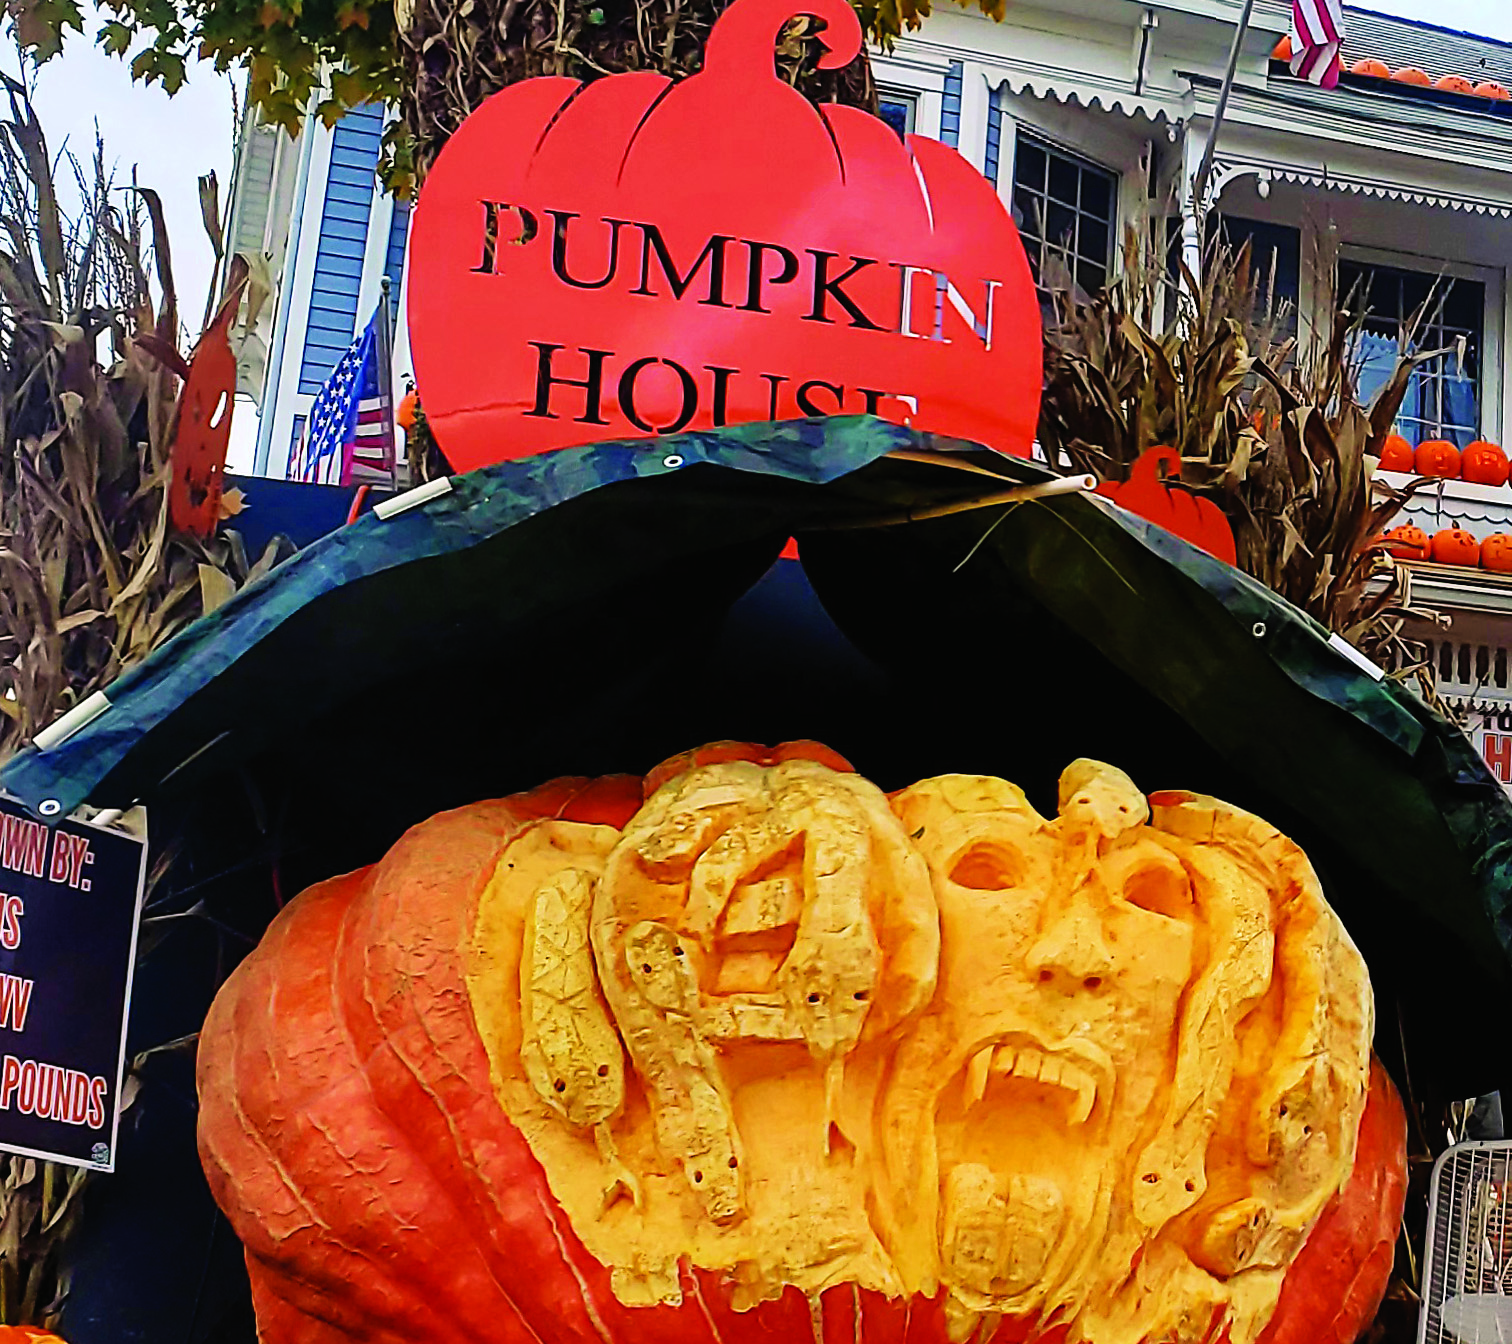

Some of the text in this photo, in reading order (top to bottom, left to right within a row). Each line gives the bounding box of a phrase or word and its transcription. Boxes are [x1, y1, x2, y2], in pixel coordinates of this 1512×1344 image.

[469, 199, 1003, 351] PUMPKIN
[0, 810, 95, 892] WN BY:
[1, 1054, 107, 1129] POUNDS
